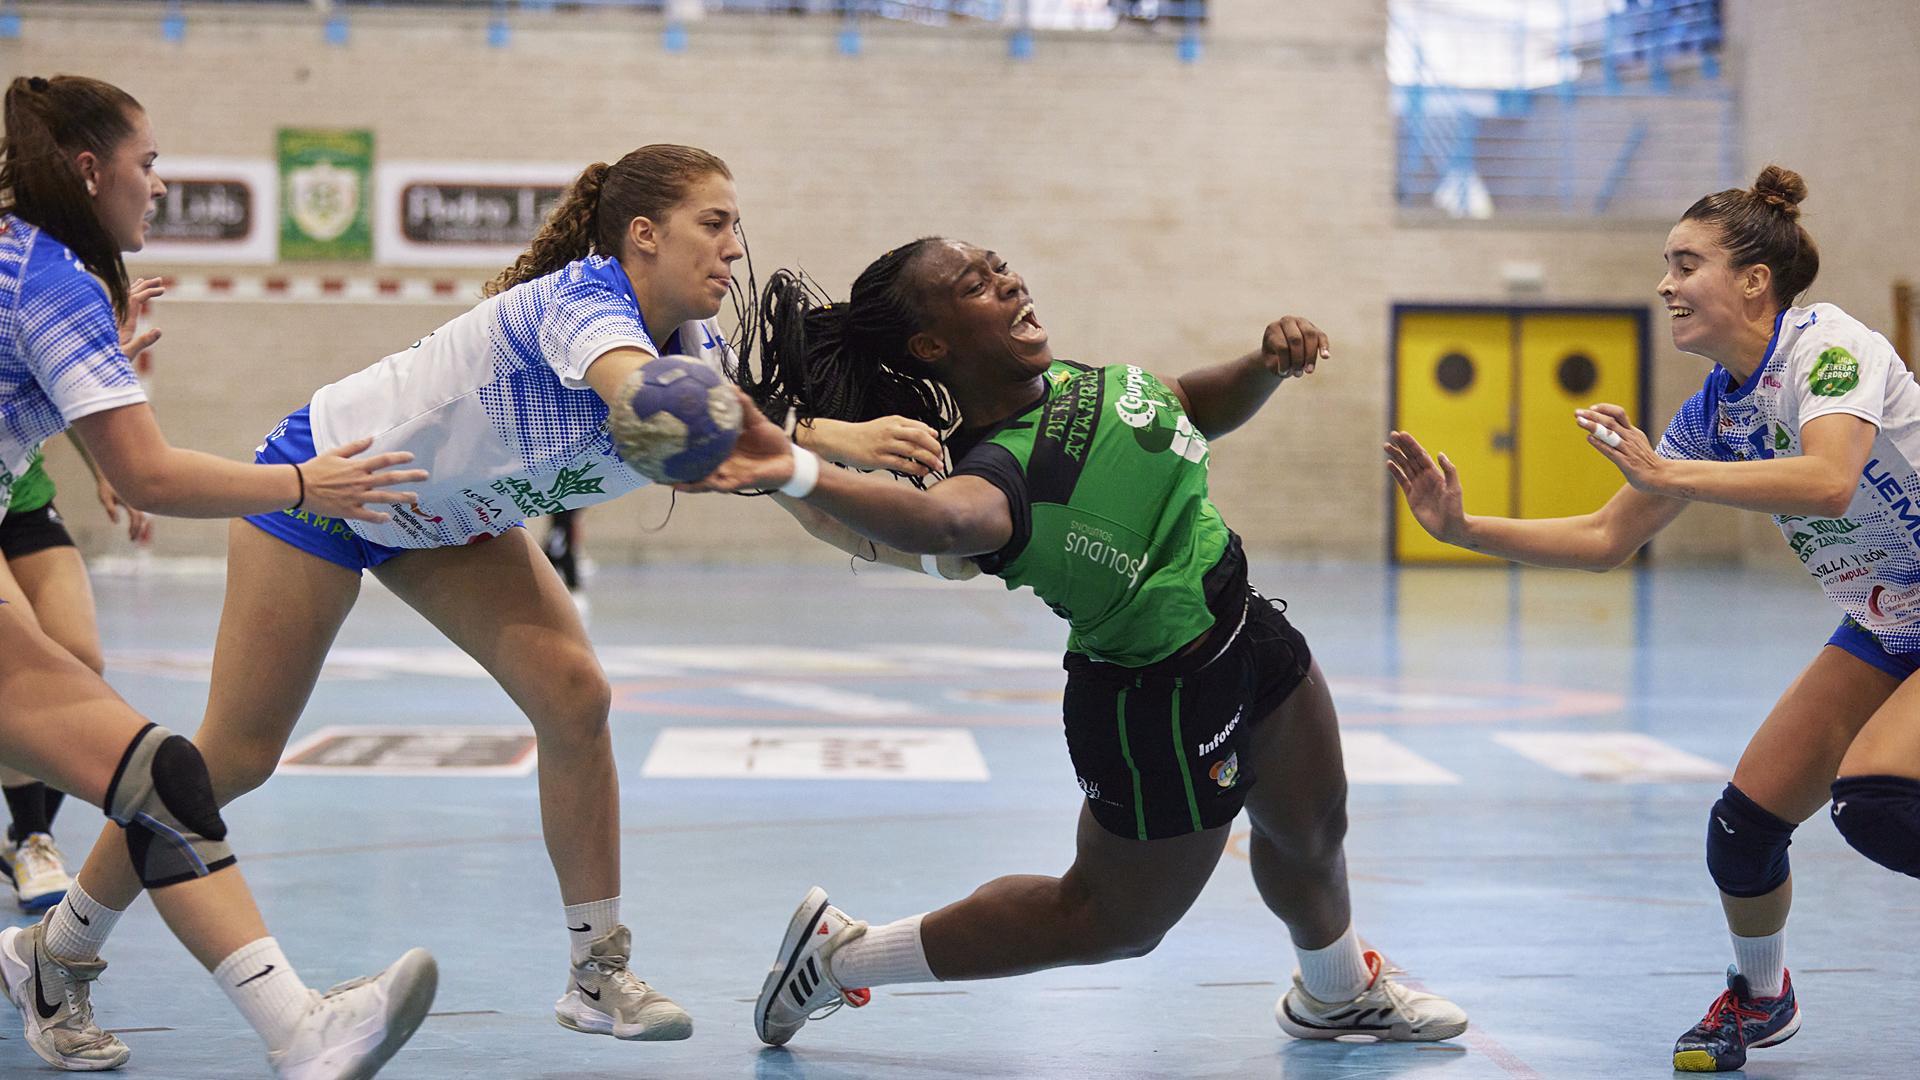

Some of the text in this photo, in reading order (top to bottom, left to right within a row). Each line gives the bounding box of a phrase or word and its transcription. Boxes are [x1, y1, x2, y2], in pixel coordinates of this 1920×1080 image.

[1070, 520, 1114, 543] SOLUTIONS
[1064, 532, 1140, 578] SOLIDUS
[1800, 545, 1817, 564] DE
